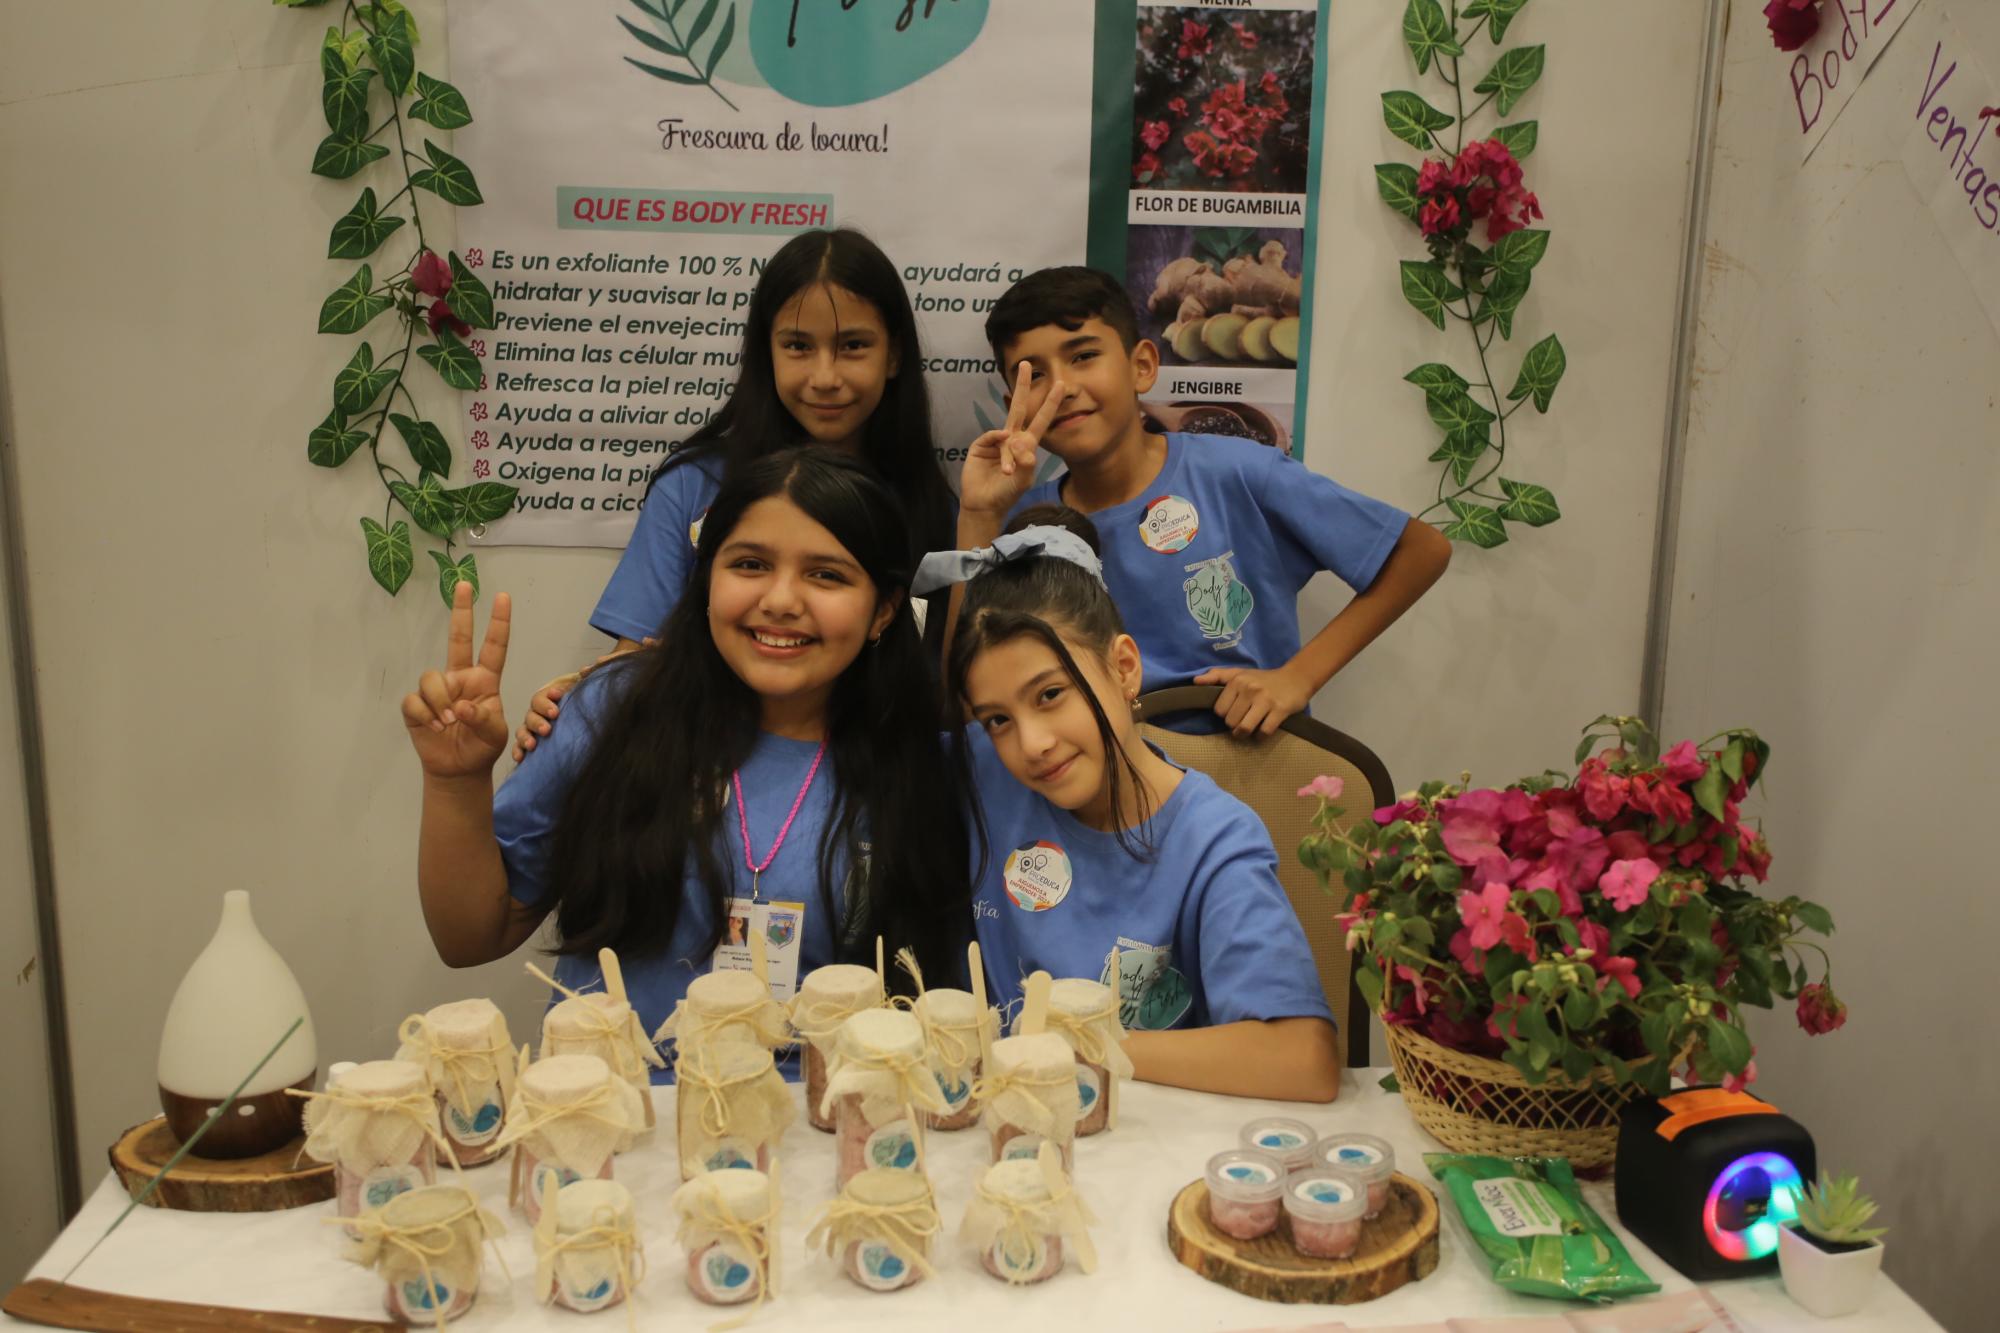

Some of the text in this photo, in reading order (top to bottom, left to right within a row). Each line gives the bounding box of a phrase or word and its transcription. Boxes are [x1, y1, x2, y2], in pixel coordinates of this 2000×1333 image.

[658, 118, 889, 153] Frescura de locura!
[573, 197, 828, 226] QUE ES BODY FRESH
[1136, 196, 1301, 215] FLOR DE BUGAMBILIA
[492, 250, 515, 269] Es
[521, 255, 549, 270] un
[556, 252, 670, 274] exfoliante
[679, 255, 716, 276] 100
[722, 256, 742, 276] %
[903, 261, 1001, 285] ayudará
[1007, 268, 1024, 282] a
[493, 280, 583, 302] hidratar
[588, 287, 602, 307] y
[607, 285, 702, 305] suavisar
[706, 286, 727, 306] la
[914, 292, 966, 313] tono
[494, 311, 593, 333] Previene
[599, 314, 621, 333] el
[494, 342, 575, 363] Elimina
[581, 344, 613, 364] las
[619, 343, 698, 366] célular
[495, 371, 594, 393] Refresca
[599, 375, 621, 394] la
[626, 376, 669, 398] piel
[1170, 381, 1243, 396] JENGIBRE
[495, 403, 572, 426] Ayuda
[578, 408, 594, 423] a
[600, 405, 668, 425] aliviar
[496, 432, 573, 455] Ayuda
[579, 437, 595, 452] a
[498, 461, 595, 485] Oxigena
[601, 464, 622, 482] la
[511, 492, 574, 514] yuda
[580, 496, 596, 511] a
[1029, 870, 1060, 891] PROEDUCA
